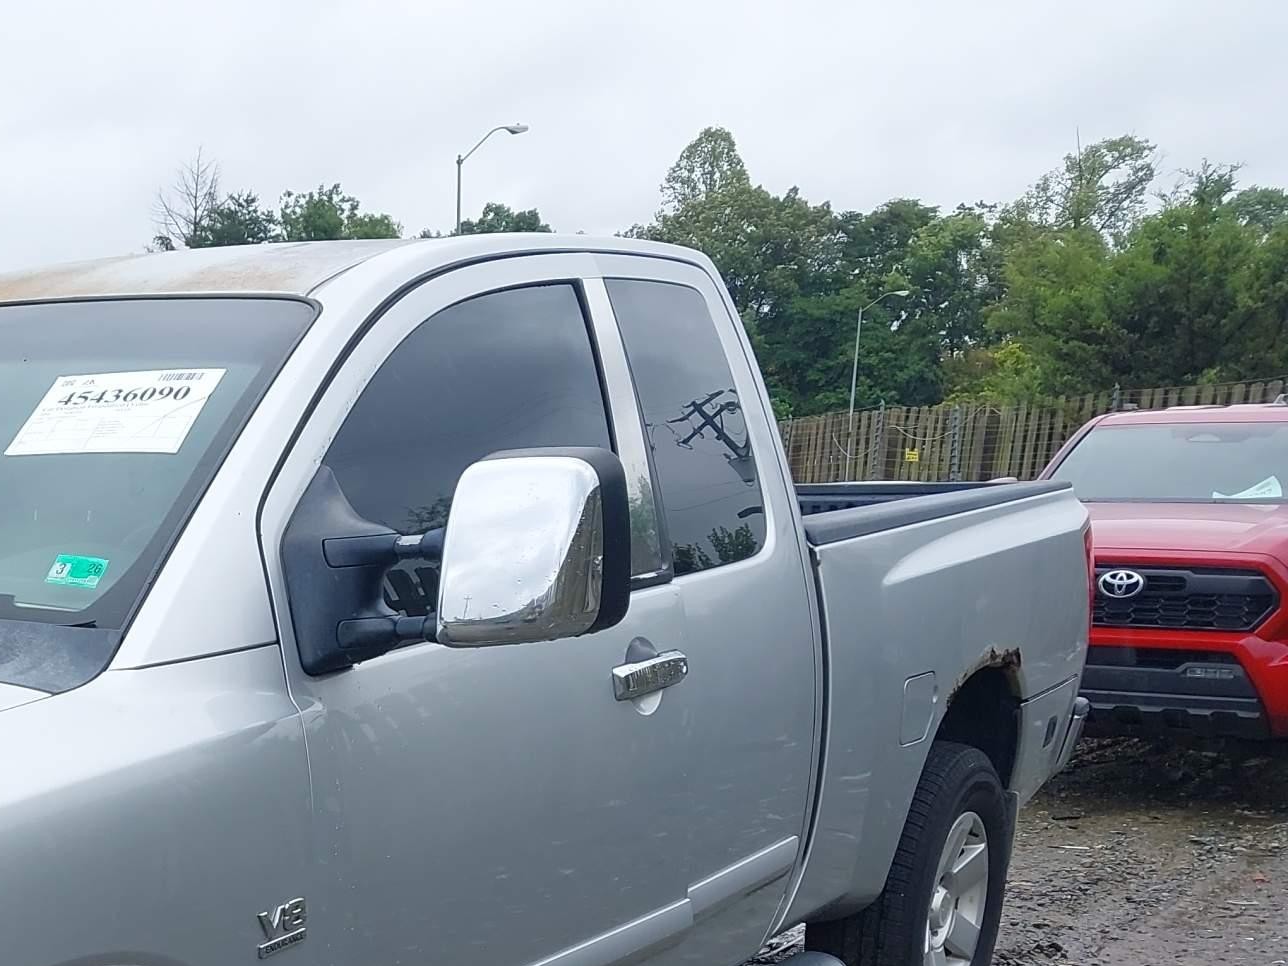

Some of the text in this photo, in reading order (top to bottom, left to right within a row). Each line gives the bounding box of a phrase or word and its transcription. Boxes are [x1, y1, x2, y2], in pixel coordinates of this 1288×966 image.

[58, 385, 192, 405] 45436090
[55, 563, 103, 576] 3 26
[256, 897, 305, 941] V8
